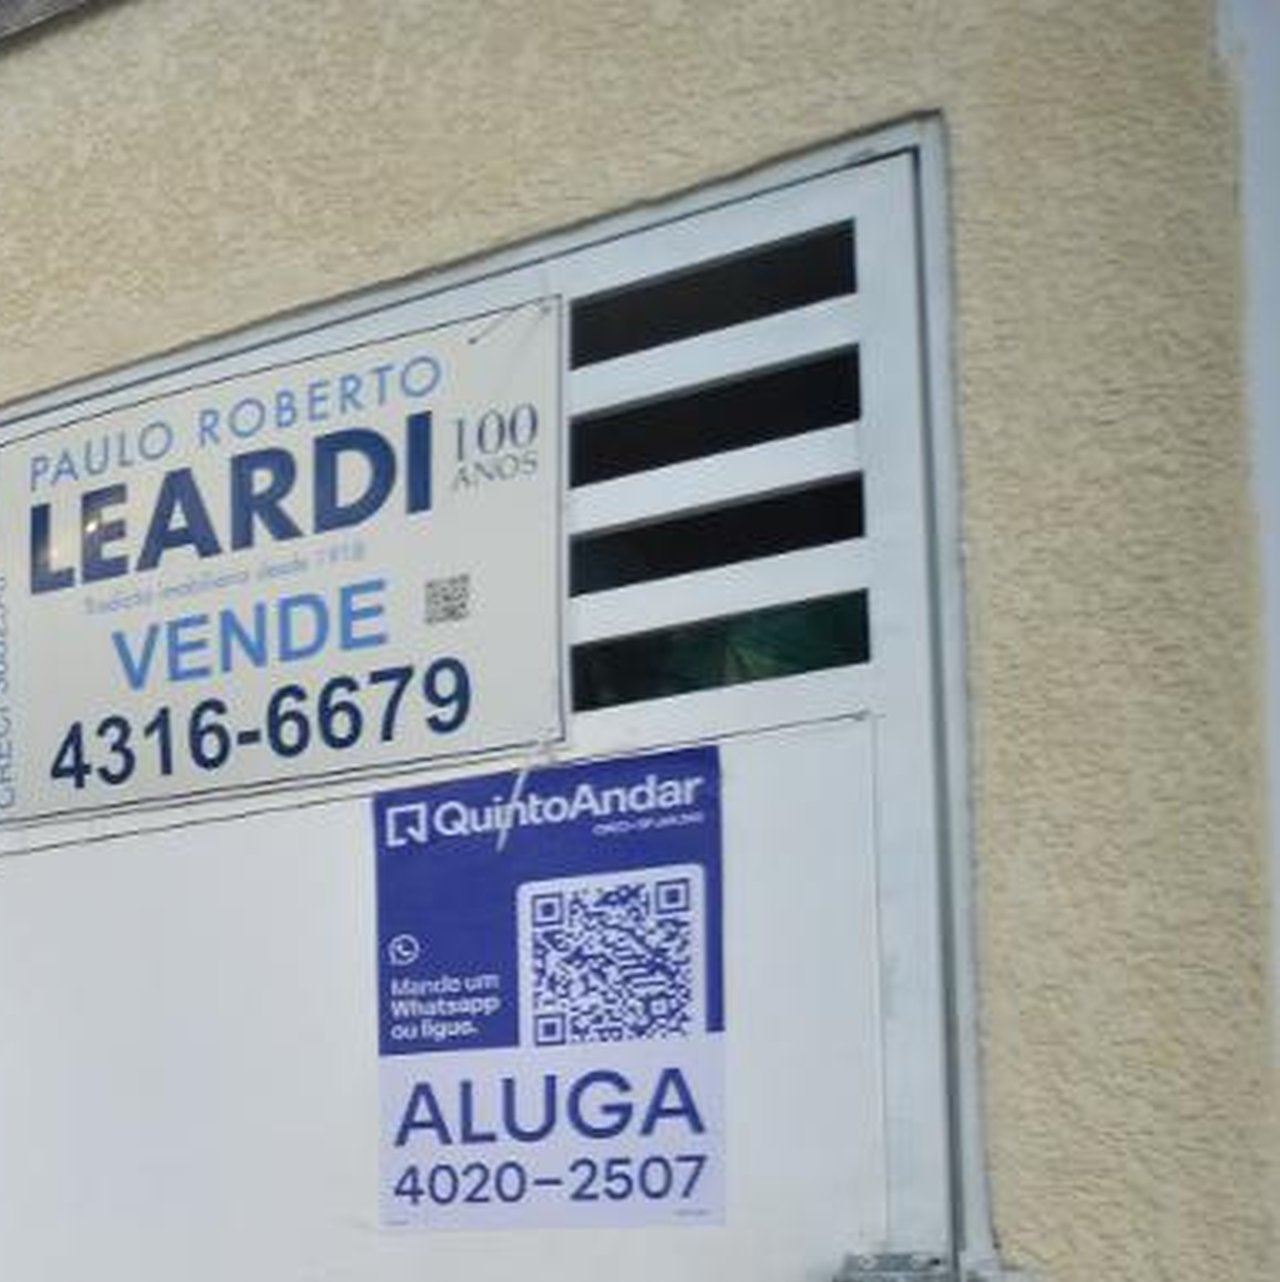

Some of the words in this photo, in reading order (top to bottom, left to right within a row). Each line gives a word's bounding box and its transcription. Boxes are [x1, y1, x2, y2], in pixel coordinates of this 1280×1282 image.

[30, 421, 173, 491] PAULO
[198, 355, 442, 448] ROBERTO
[452, 403, 538, 462] 100
[450, 450, 539, 492] ANOS
[30, 411, 433, 595] LEARDI
[112, 579, 388, 691] VENDE
[50, 656, 471, 789] 4316-6679
[434, 774, 705, 837] QuintoAndar
[391, 976, 461, 997] Mande
[464, 973, 500, 990] um
[391, 995, 501, 1019] Whatsapp
[391, 1024, 418, 1039] ou
[394, 1067, 706, 1148] ALUGA
[394, 1154, 708, 1205] 4020-2507
